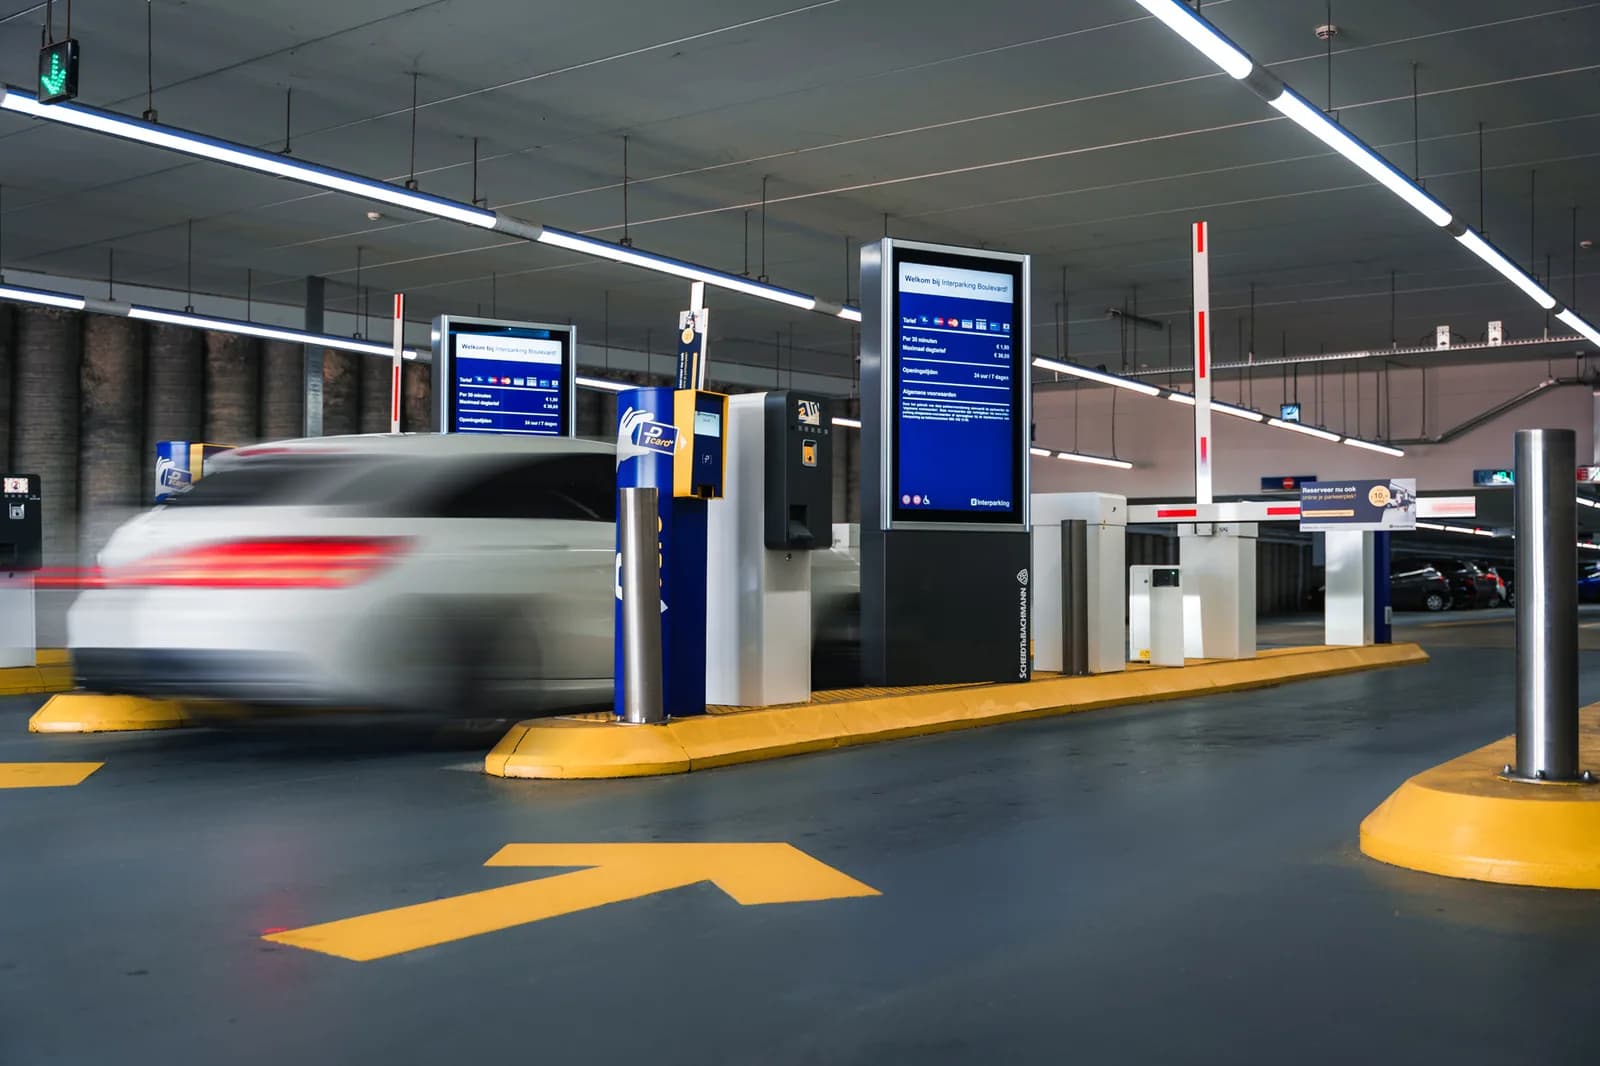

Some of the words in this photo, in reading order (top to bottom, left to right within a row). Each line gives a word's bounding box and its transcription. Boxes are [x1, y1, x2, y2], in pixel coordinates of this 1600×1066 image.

[904, 275, 930, 284] Welkom
[932, 278, 940, 286] bij
[942, 279, 976, 290] Interparking
[978, 283, 1008, 292] Boulevard!
[462, 343, 485, 351] Welkom
[902, 344, 925, 352] Maximaal
[926, 346, 946, 354] dagtarief
[902, 366, 938, 375] Openingstijden
[902, 388, 926, 396] Algemene
[977, 499, 1010, 508] Interparking
